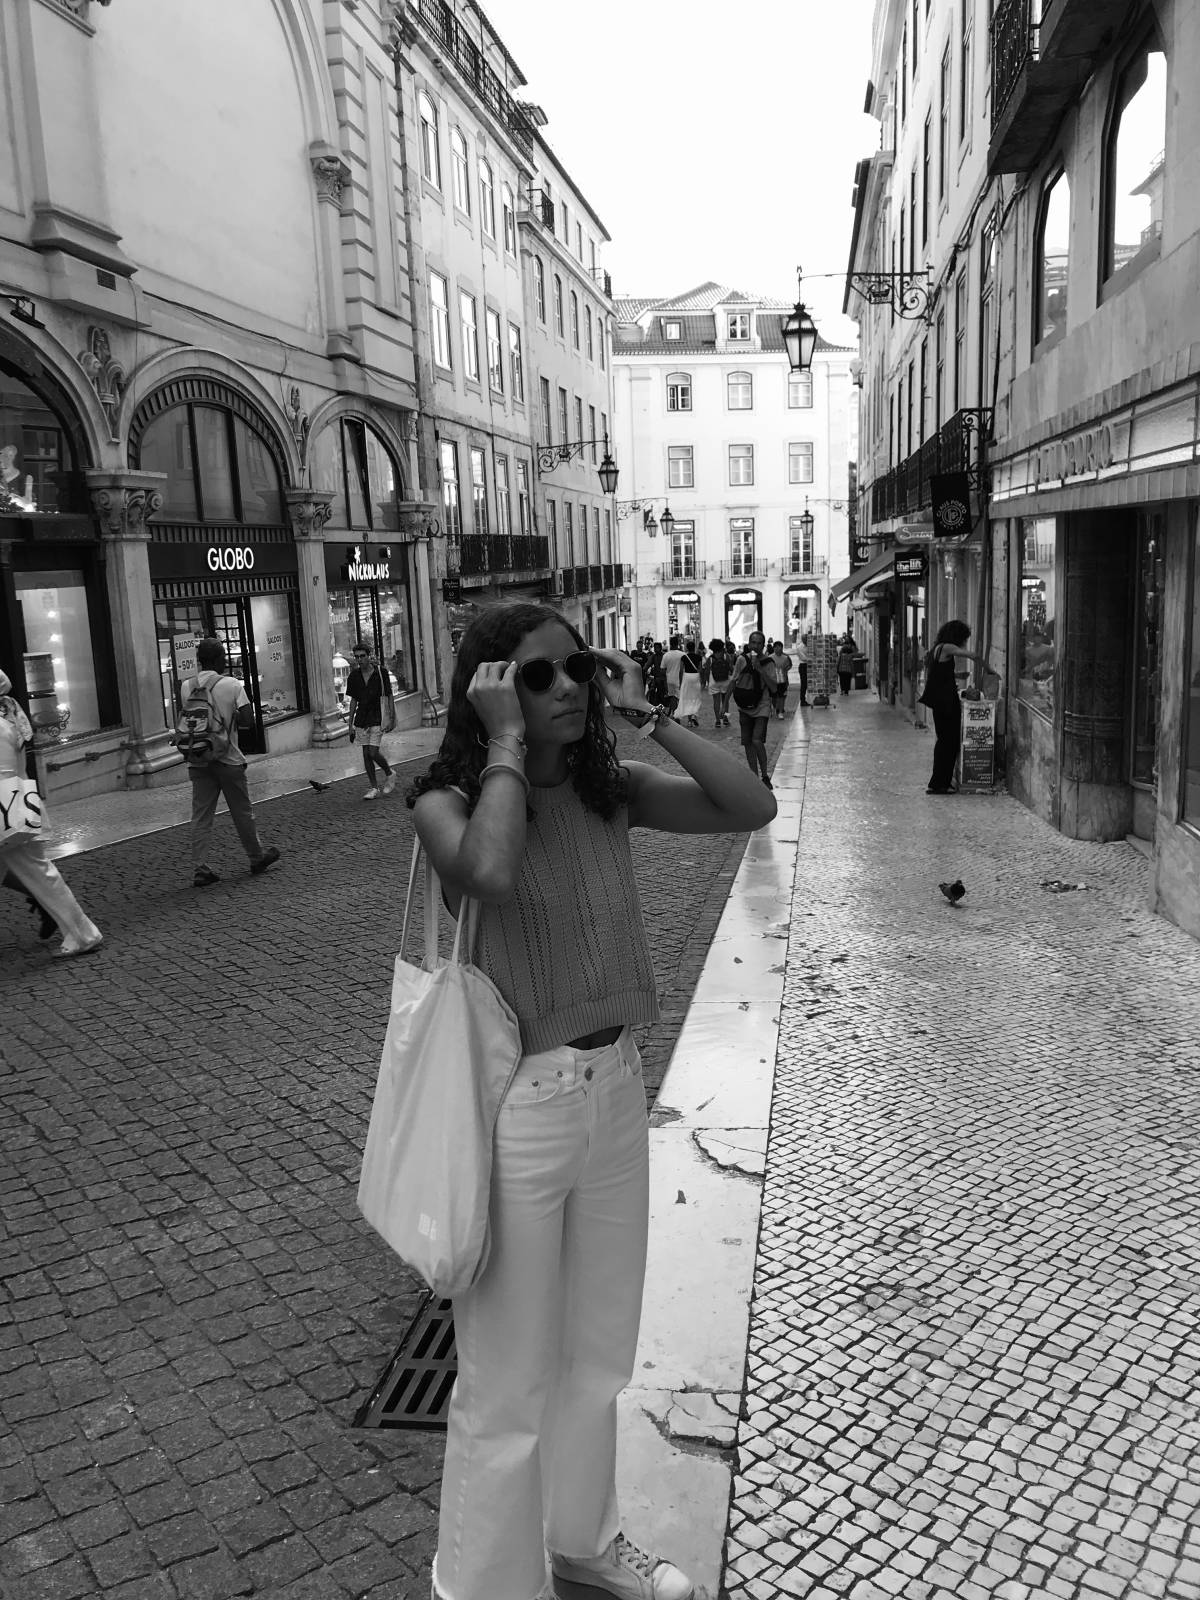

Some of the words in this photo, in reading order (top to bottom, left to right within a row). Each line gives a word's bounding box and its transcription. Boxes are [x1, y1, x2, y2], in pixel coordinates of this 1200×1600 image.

[950, 499, 967, 514] PORTO
[207, 547, 254, 571] GLOBO
[897, 561, 909, 571] the
[910, 559, 922, 570] lift
[348, 562, 390, 581] NICKOLAUS
[175, 640, 195, 651] SALDOS
